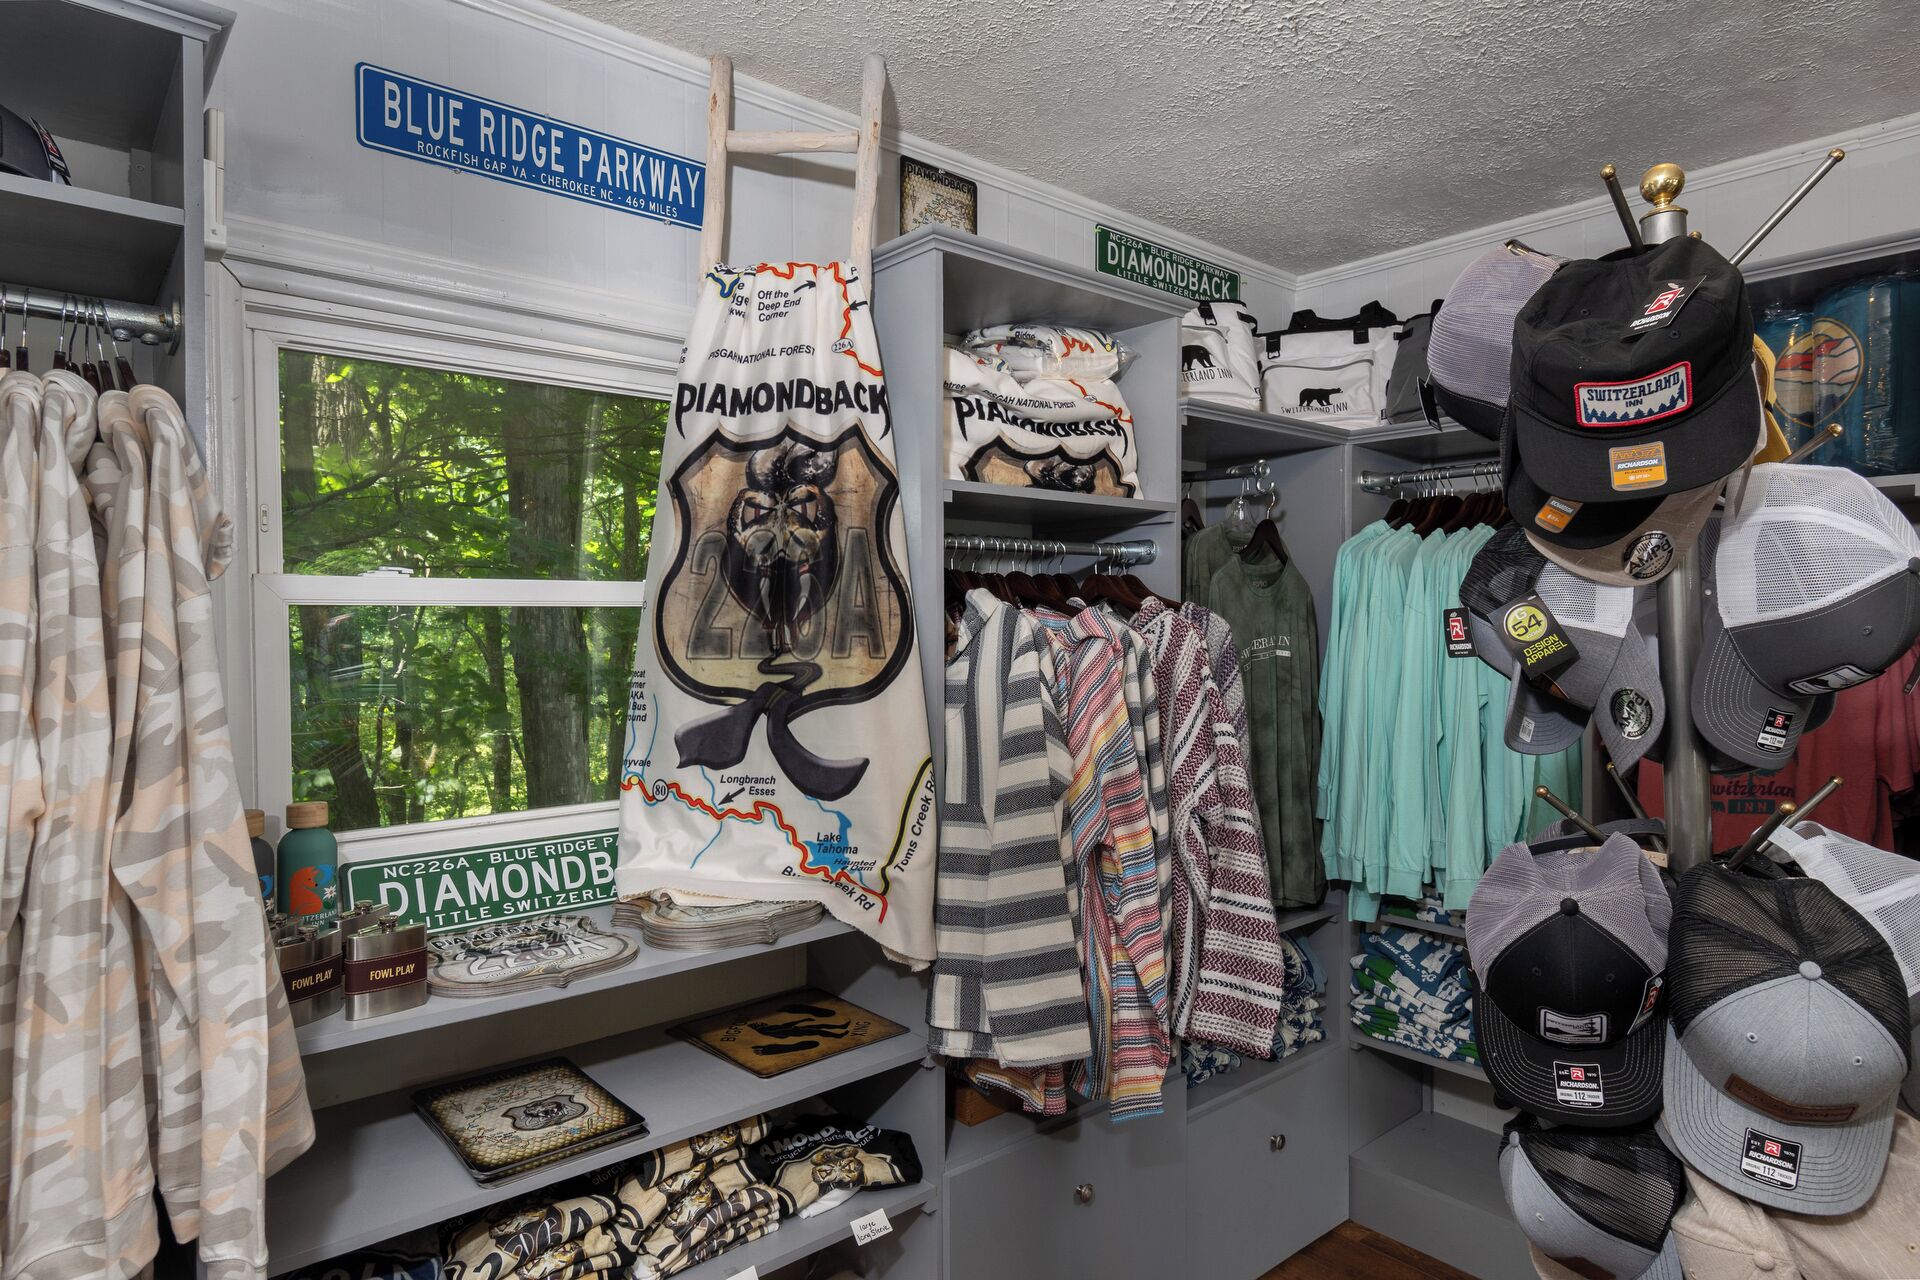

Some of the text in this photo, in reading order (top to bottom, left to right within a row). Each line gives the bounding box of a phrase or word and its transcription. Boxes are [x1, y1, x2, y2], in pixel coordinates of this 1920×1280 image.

[384, 80, 700, 208] BLUE RIDGE PARKWAY
[416, 140, 479, 167] ROCKFISH
[483, 157, 507, 173] GAP
[512, 164, 527, 179] VA
[540, 173, 596, 197] CHEROKEE
[600, 188, 614, 202] NC
[626, 196, 646, 209] 469
[649, 203, 679, 218] MILES
[906, 162, 974, 197] DIAMONDBACK
[1109, 232, 1143, 250] NC226A
[1150, 246, 1170, 259] BLUE
[1172, 254, 1194, 267] RIDGE
[1196, 261, 1229, 279] PARKWAY
[1107, 241, 1231, 300] DIAMONDBACK
[1116, 268, 1149, 285] LITTLE
[758, 290, 789, 300] Off the
[758, 298, 801, 311] Deep End
[759, 311, 789, 322] Corner
[737, 349, 777, 364] NATIONAL
[1217, 367, 1233, 380] INN
[1587, 371, 1681, 402] SWITZERLAND
[675, 378, 891, 438] DIAMONDBACK
[1015, 397, 1051, 409] NATIONAL
[1332, 402, 1348, 414] INN
[1625, 399, 1643, 408] INN
[1617, 459, 1659, 470] RICHARDSON
[1515, 608, 1528, 620] G
[1512, 613, 1543, 637] 54
[1523, 634, 1559, 657] DESIGN
[1526, 640, 1568, 666] APPAREL
[632, 702, 647, 711] Bus
[720, 775, 776, 788] Longbranch
[655, 785, 666, 796] 80
[749, 786, 776, 796] Esses
[1712, 780, 1795, 798] witzerlan
[1736, 801, 1769, 812] INN
[817, 832, 841, 843] Lake
[894, 840, 918, 874] Toms
[911, 794, 933, 837] Creek
[817, 843, 859, 854] Tahoma
[384, 857, 470, 879] NC226A
[489, 847, 539, 865] BLUE
[544, 838, 598, 857] RIDGE
[833, 859, 876, 867] Haunted
[379, 851, 614, 917] DIAMONDB
[503, 885, 618, 915] SWITZERLA
[855, 894, 876, 911] Rd
[431, 919, 569, 950] DIAMONDBACK
[369, 963, 415, 981] FOWL PLAY
[292, 968, 333, 991] FOWL PLAY
[1560, 1081, 1598, 1089] RICHARDSON
[1574, 1091, 1586, 1100] 112
[1749, 1151, 1793, 1170] RICHARDSON
[1762, 1166, 1776, 1177] 112
[859, 1221, 876, 1231] large
[857, 1232, 872, 1242] long
